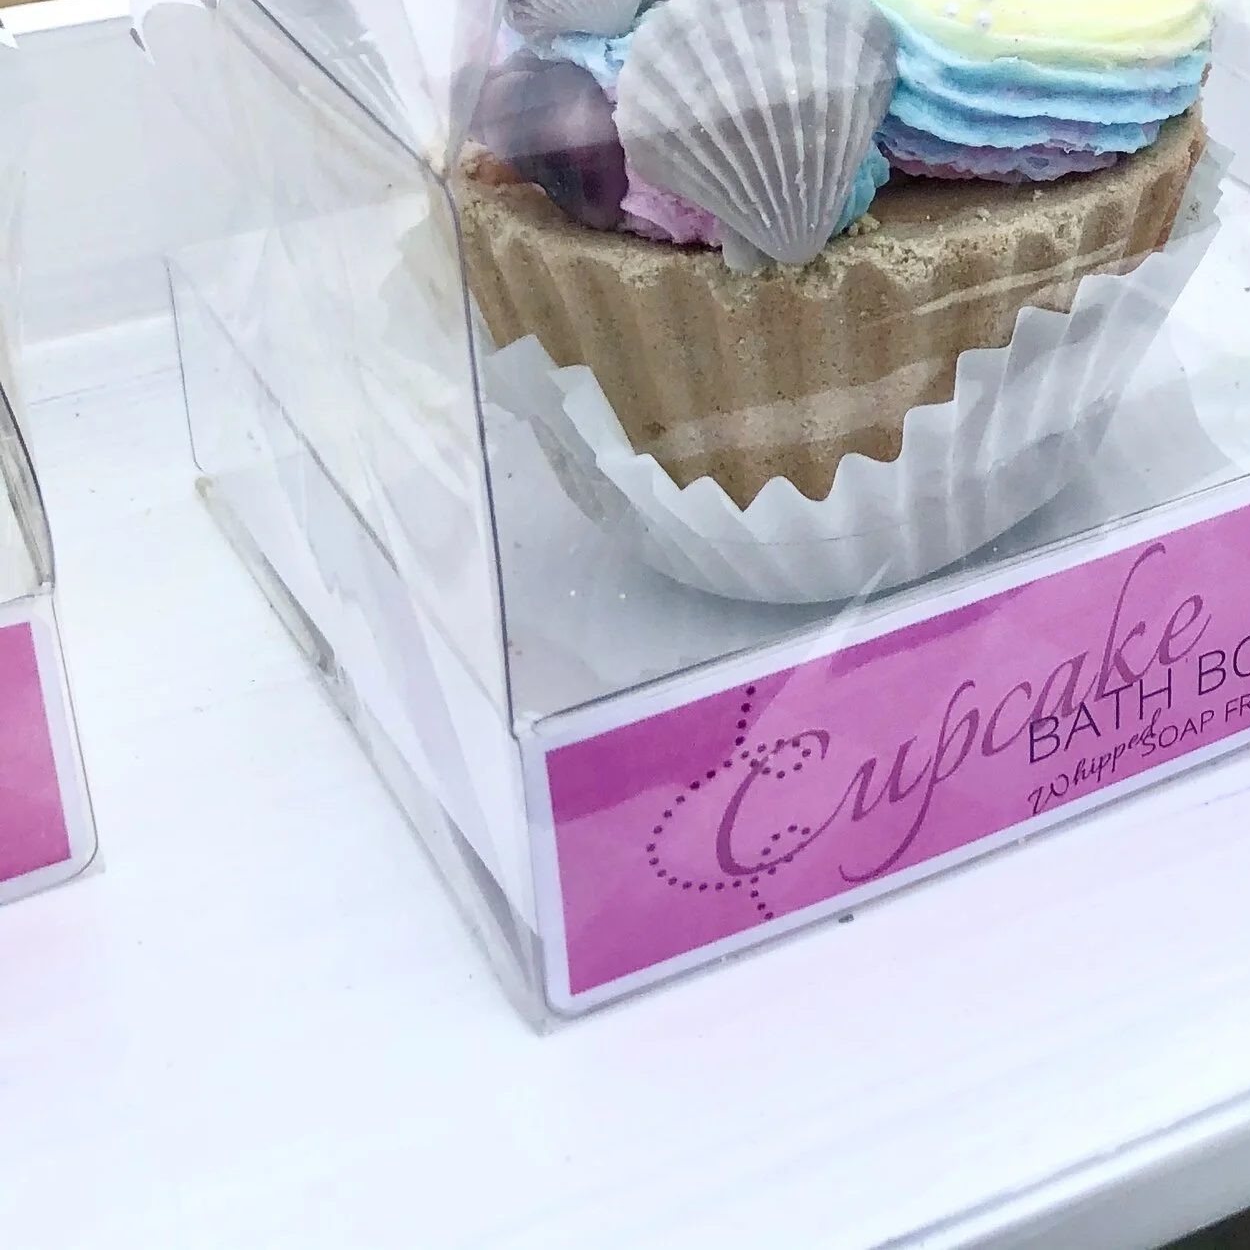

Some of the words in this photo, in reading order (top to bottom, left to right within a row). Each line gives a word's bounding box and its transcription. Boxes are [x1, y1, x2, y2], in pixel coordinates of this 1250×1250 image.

[714, 542, 1212, 883] Cupcake
[1027, 707, 1162, 817] Whipped
[1140, 709, 1216, 758] SOAP
[1028, 667, 1173, 765] BATH
